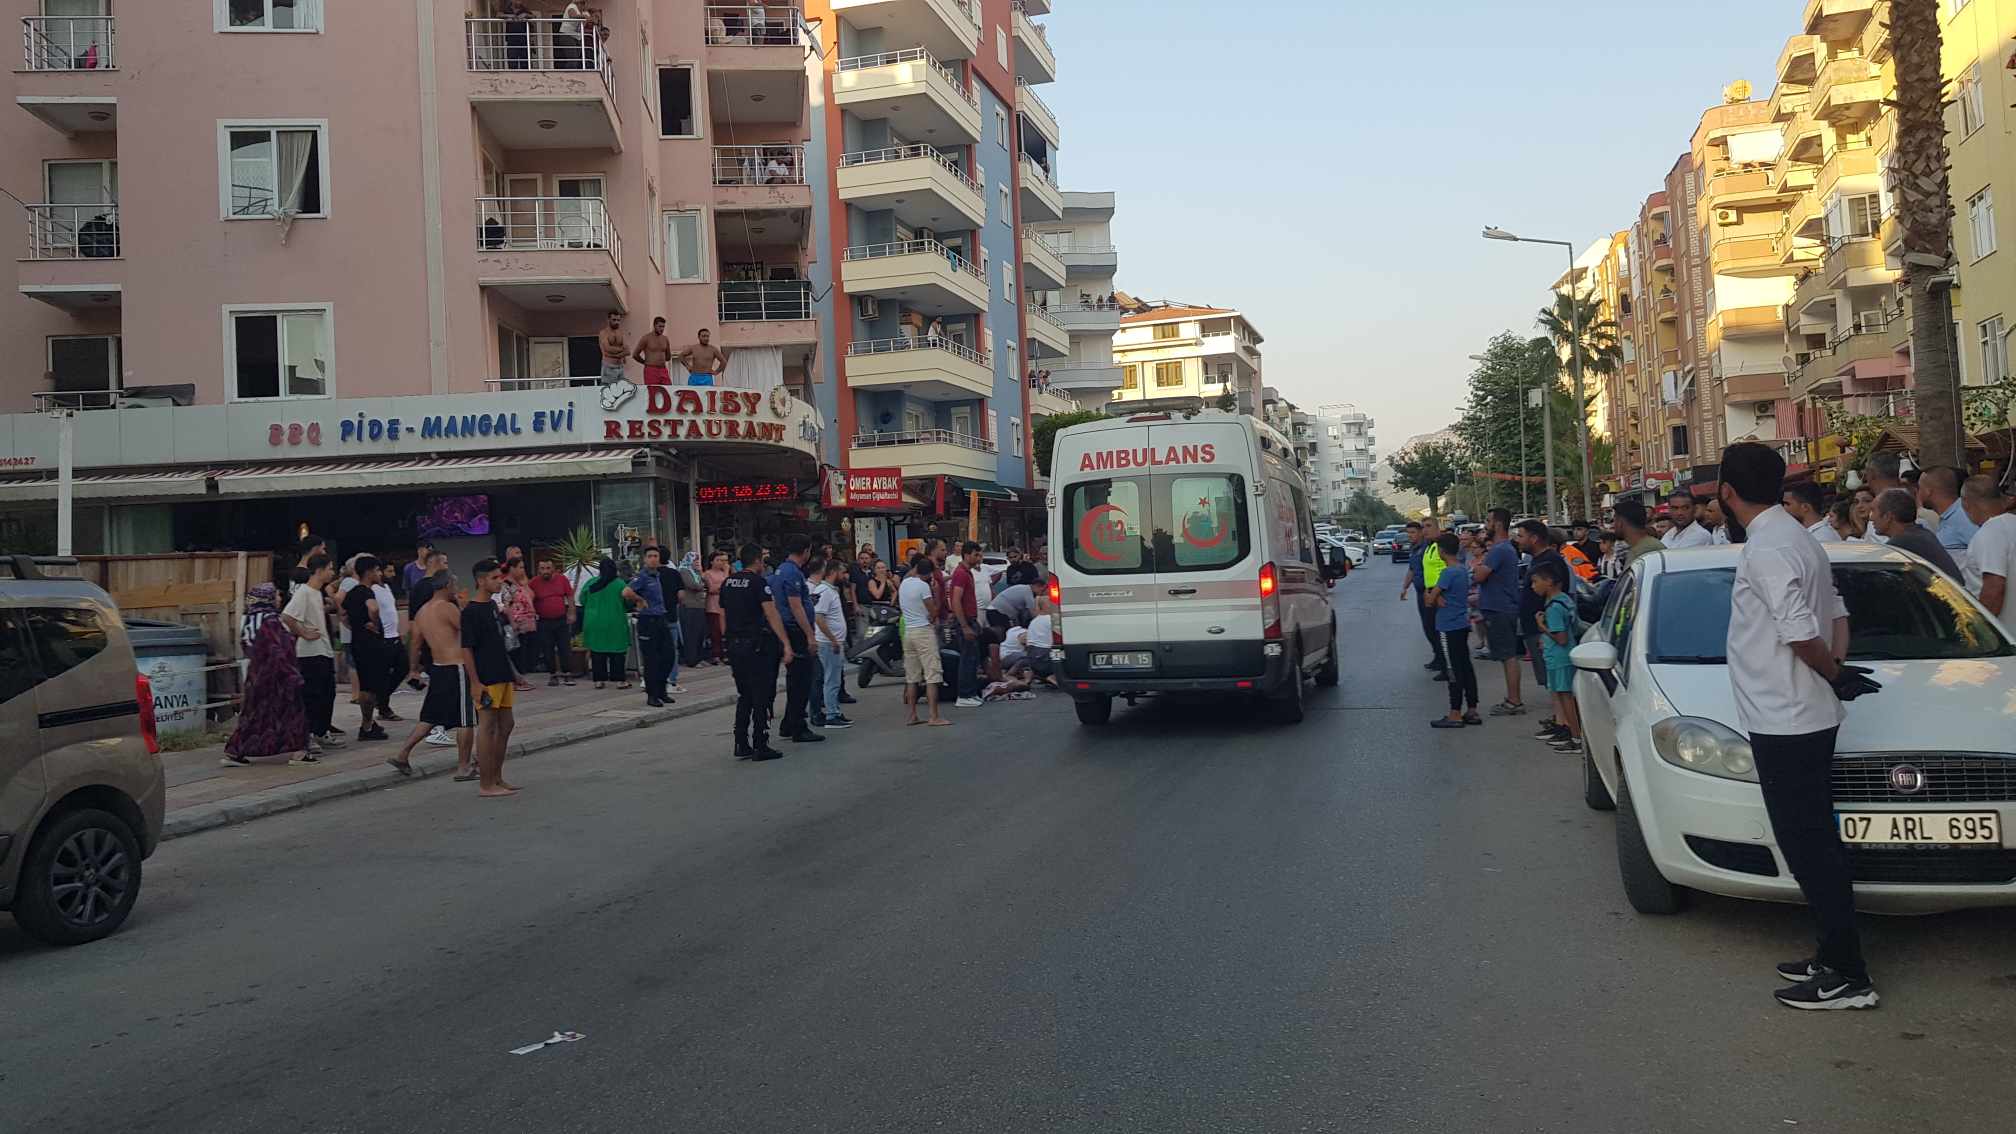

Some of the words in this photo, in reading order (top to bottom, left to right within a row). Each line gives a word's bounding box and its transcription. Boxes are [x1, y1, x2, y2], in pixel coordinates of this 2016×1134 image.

[646, 385, 762, 416] DAISY
[604, 419, 786, 442] RESTAURANT
[1079, 443, 1216, 472] AMBULANS
[850, 475, 871, 490] ÖMER
[872, 476, 898, 490] AYBAK
[1096, 520, 1126, 543] 112
[1844, 817, 1872, 840] 07
[1890, 817, 1933, 840] ARL
[1949, 817, 1993, 840] 695
